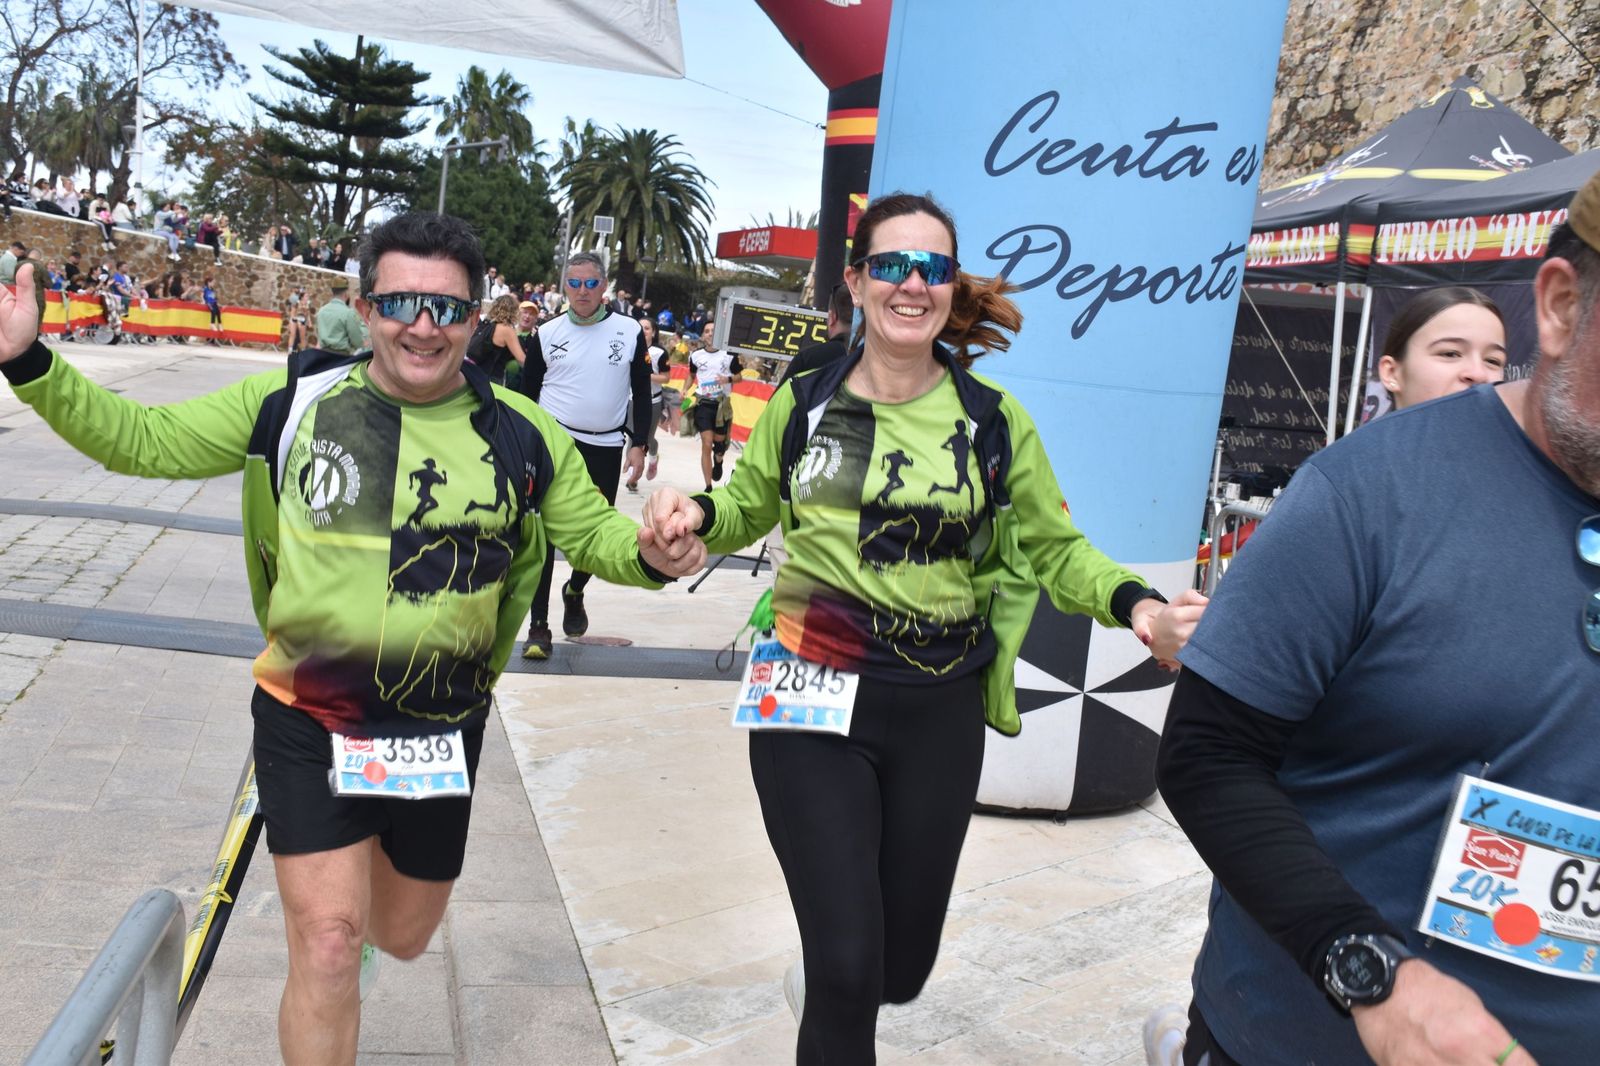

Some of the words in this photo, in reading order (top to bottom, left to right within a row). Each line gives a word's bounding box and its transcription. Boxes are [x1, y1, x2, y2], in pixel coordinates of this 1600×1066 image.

[984, 90, 1218, 181] Ceuta
[1225, 144, 1259, 185] es
[745, 230, 770, 253] CEPSA
[1248, 231, 1275, 266] DE
[1376, 217, 1477, 263] TERCIO
[985, 224, 1245, 339] Deporte
[775, 662, 846, 695] 2845
[383, 736, 453, 763] 3539
[1449, 869, 1518, 906] 20K
